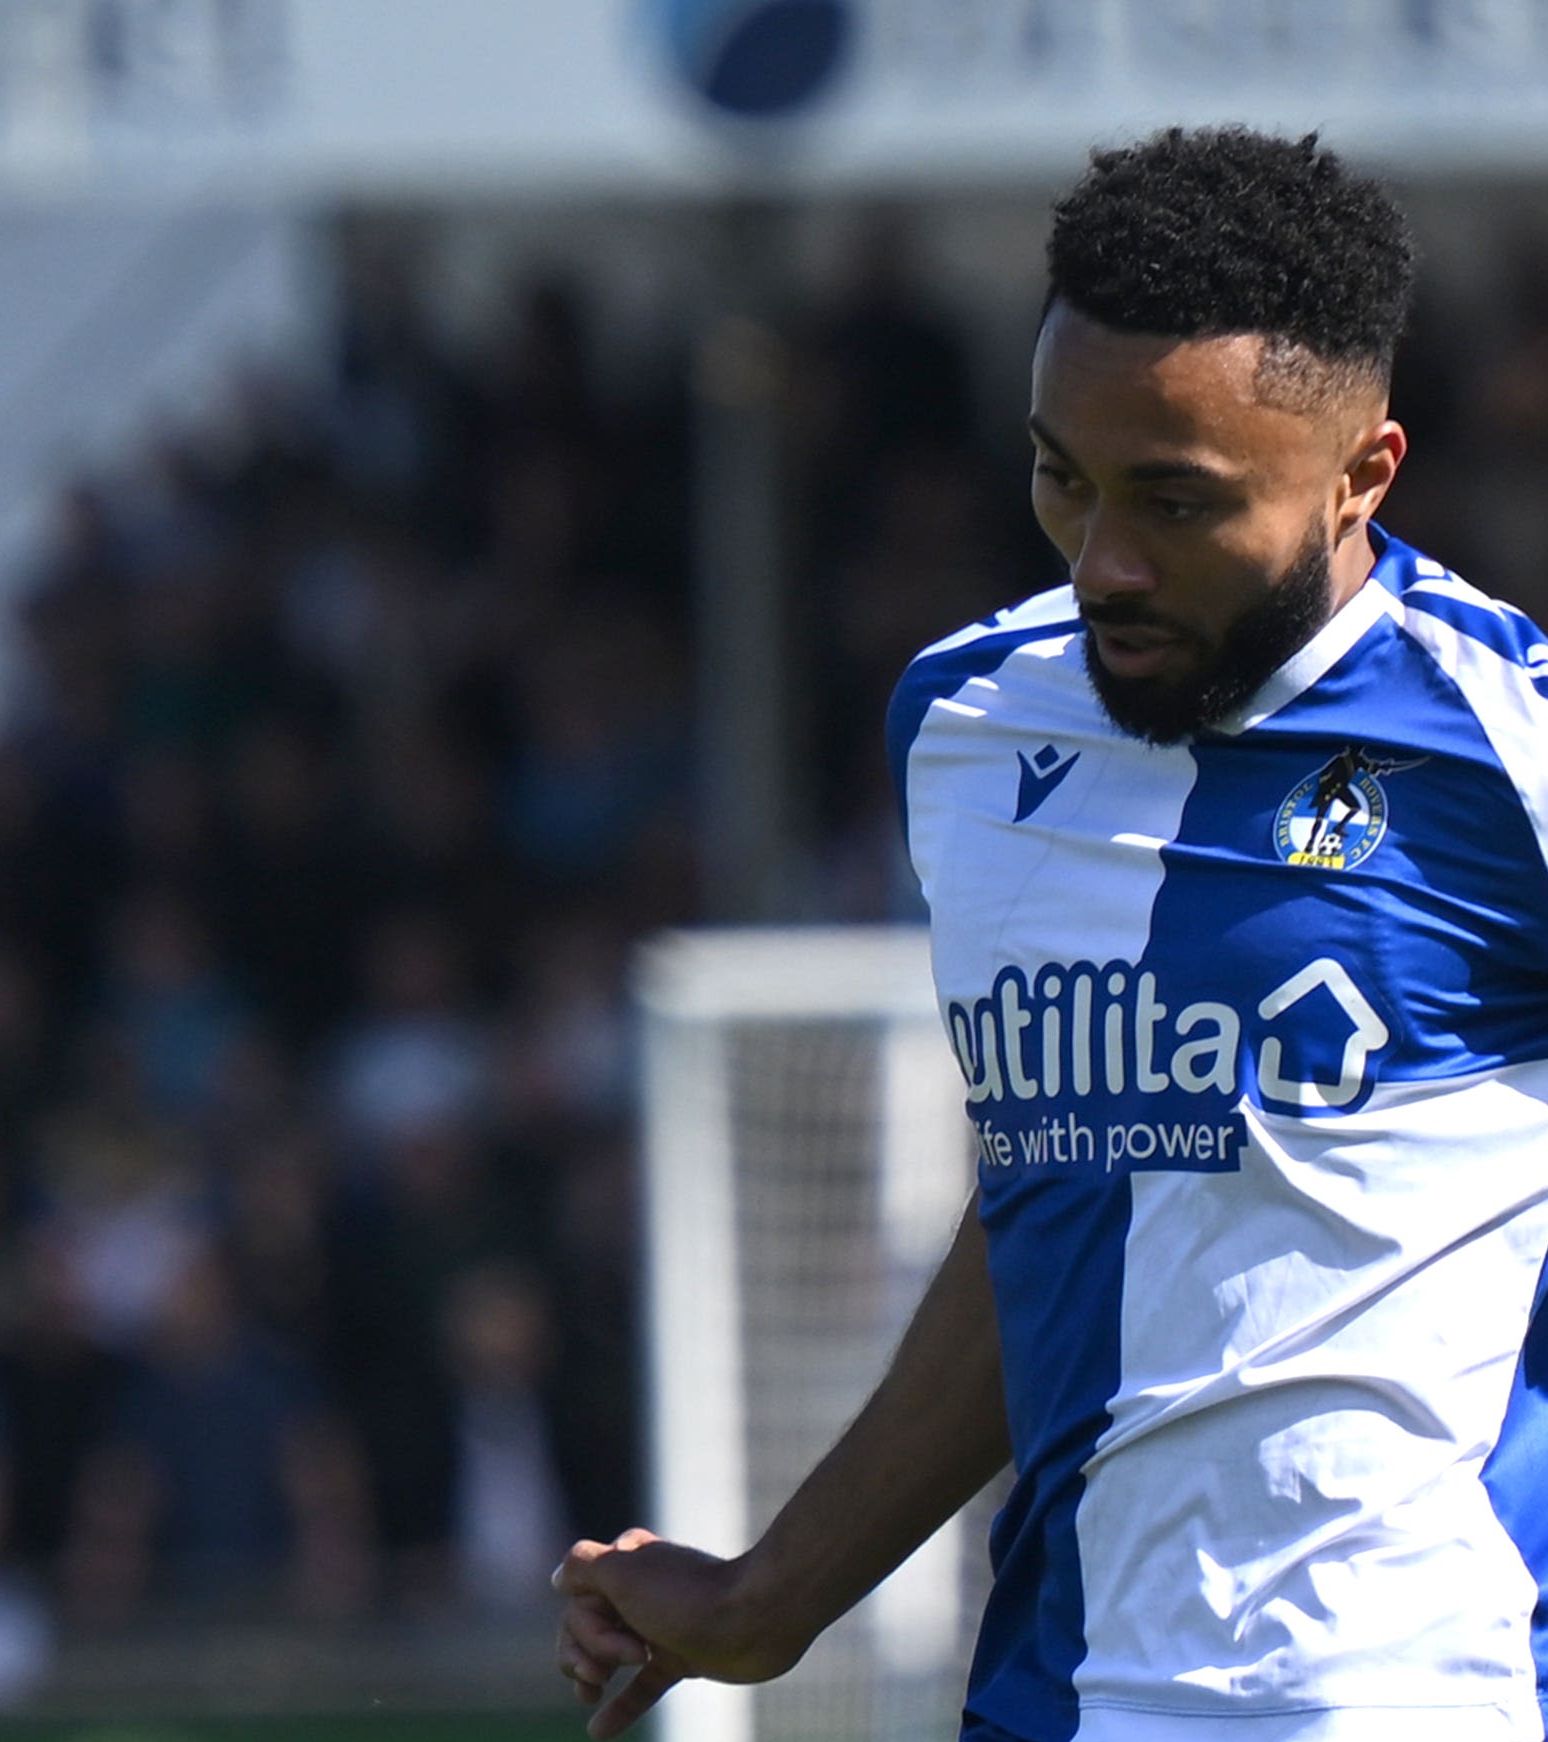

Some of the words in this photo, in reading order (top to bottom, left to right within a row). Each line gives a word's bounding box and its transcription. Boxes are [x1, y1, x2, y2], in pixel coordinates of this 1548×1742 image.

[954, 970, 1242, 1102] utilita
[1019, 1112, 1096, 1164] with
[1105, 1123, 1235, 1174] power
